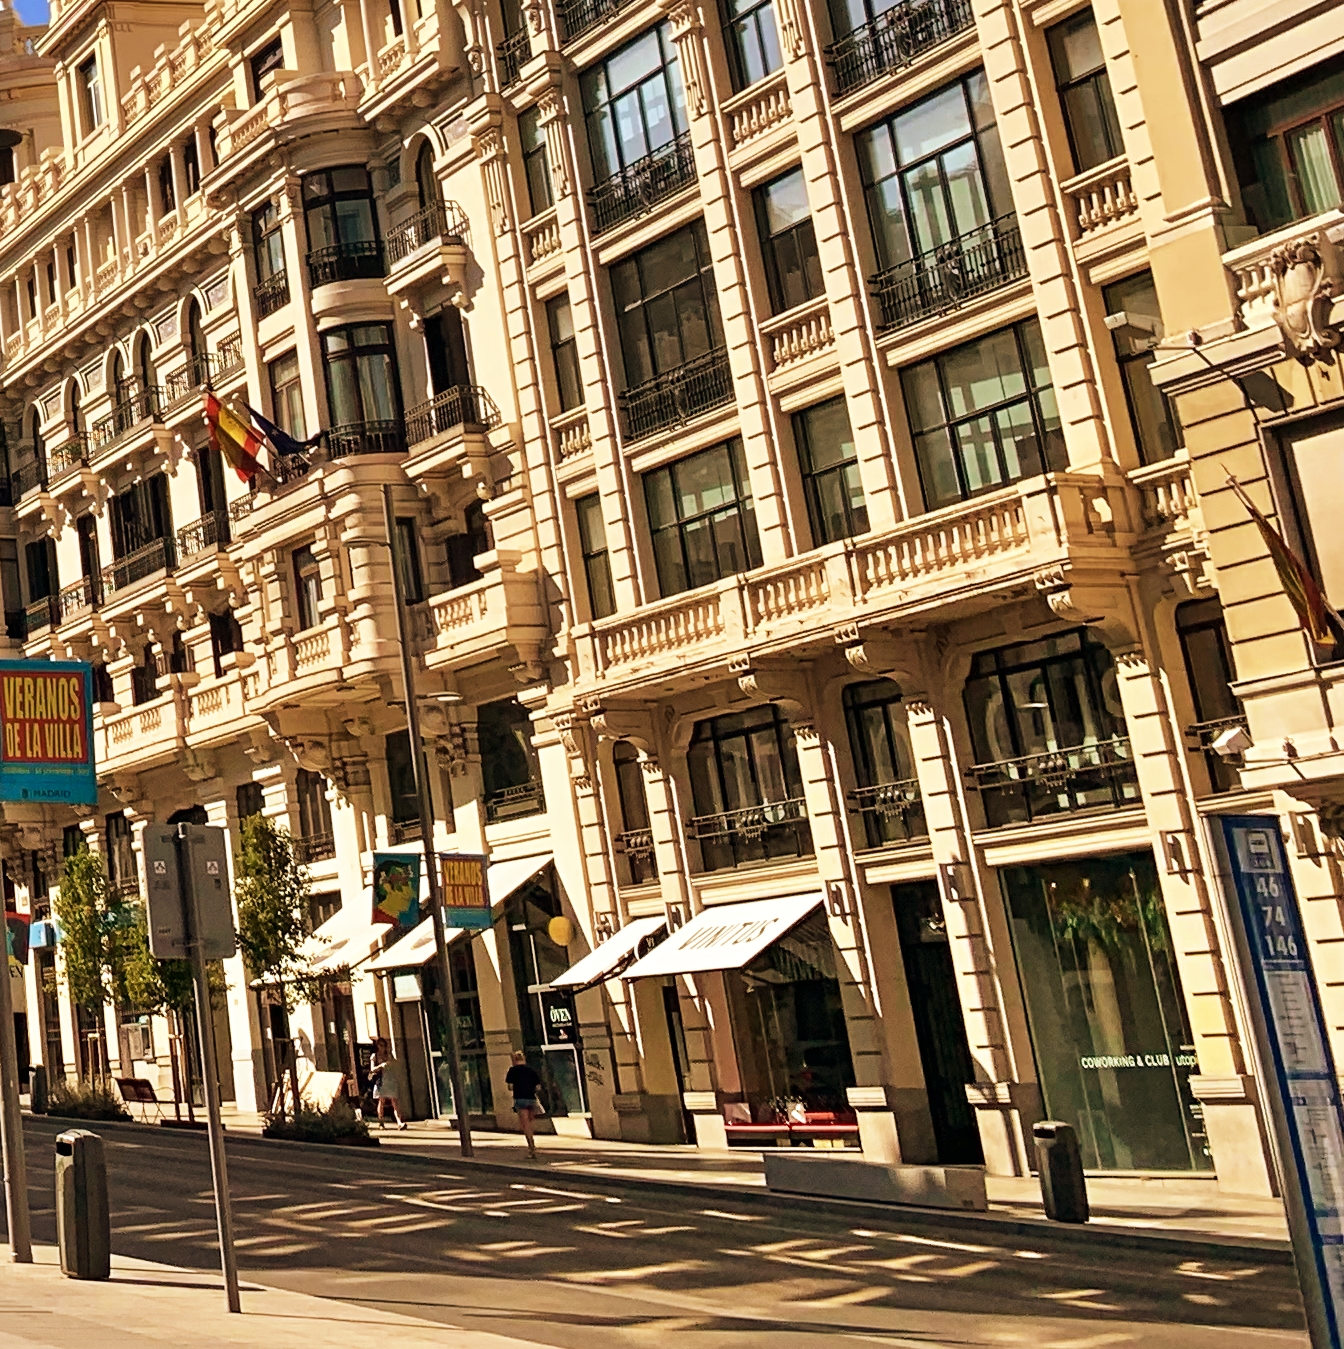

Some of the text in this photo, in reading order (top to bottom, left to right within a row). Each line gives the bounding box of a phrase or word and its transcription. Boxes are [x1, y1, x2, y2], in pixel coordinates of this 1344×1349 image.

[3, 676, 81, 721] VERANOS
[5, 722, 83, 759] DE LA VILLA
[33, 789, 71, 799] MADRID
[443, 860, 483, 886] VERANOS
[1256, 876, 1280, 899] 46
[1261, 906, 1286, 928] 74
[678, 917, 779, 951] VINITUS
[1264, 934, 1298, 957] 146
[1080, 1054, 1170, 1069] COWORKING & CLUB
